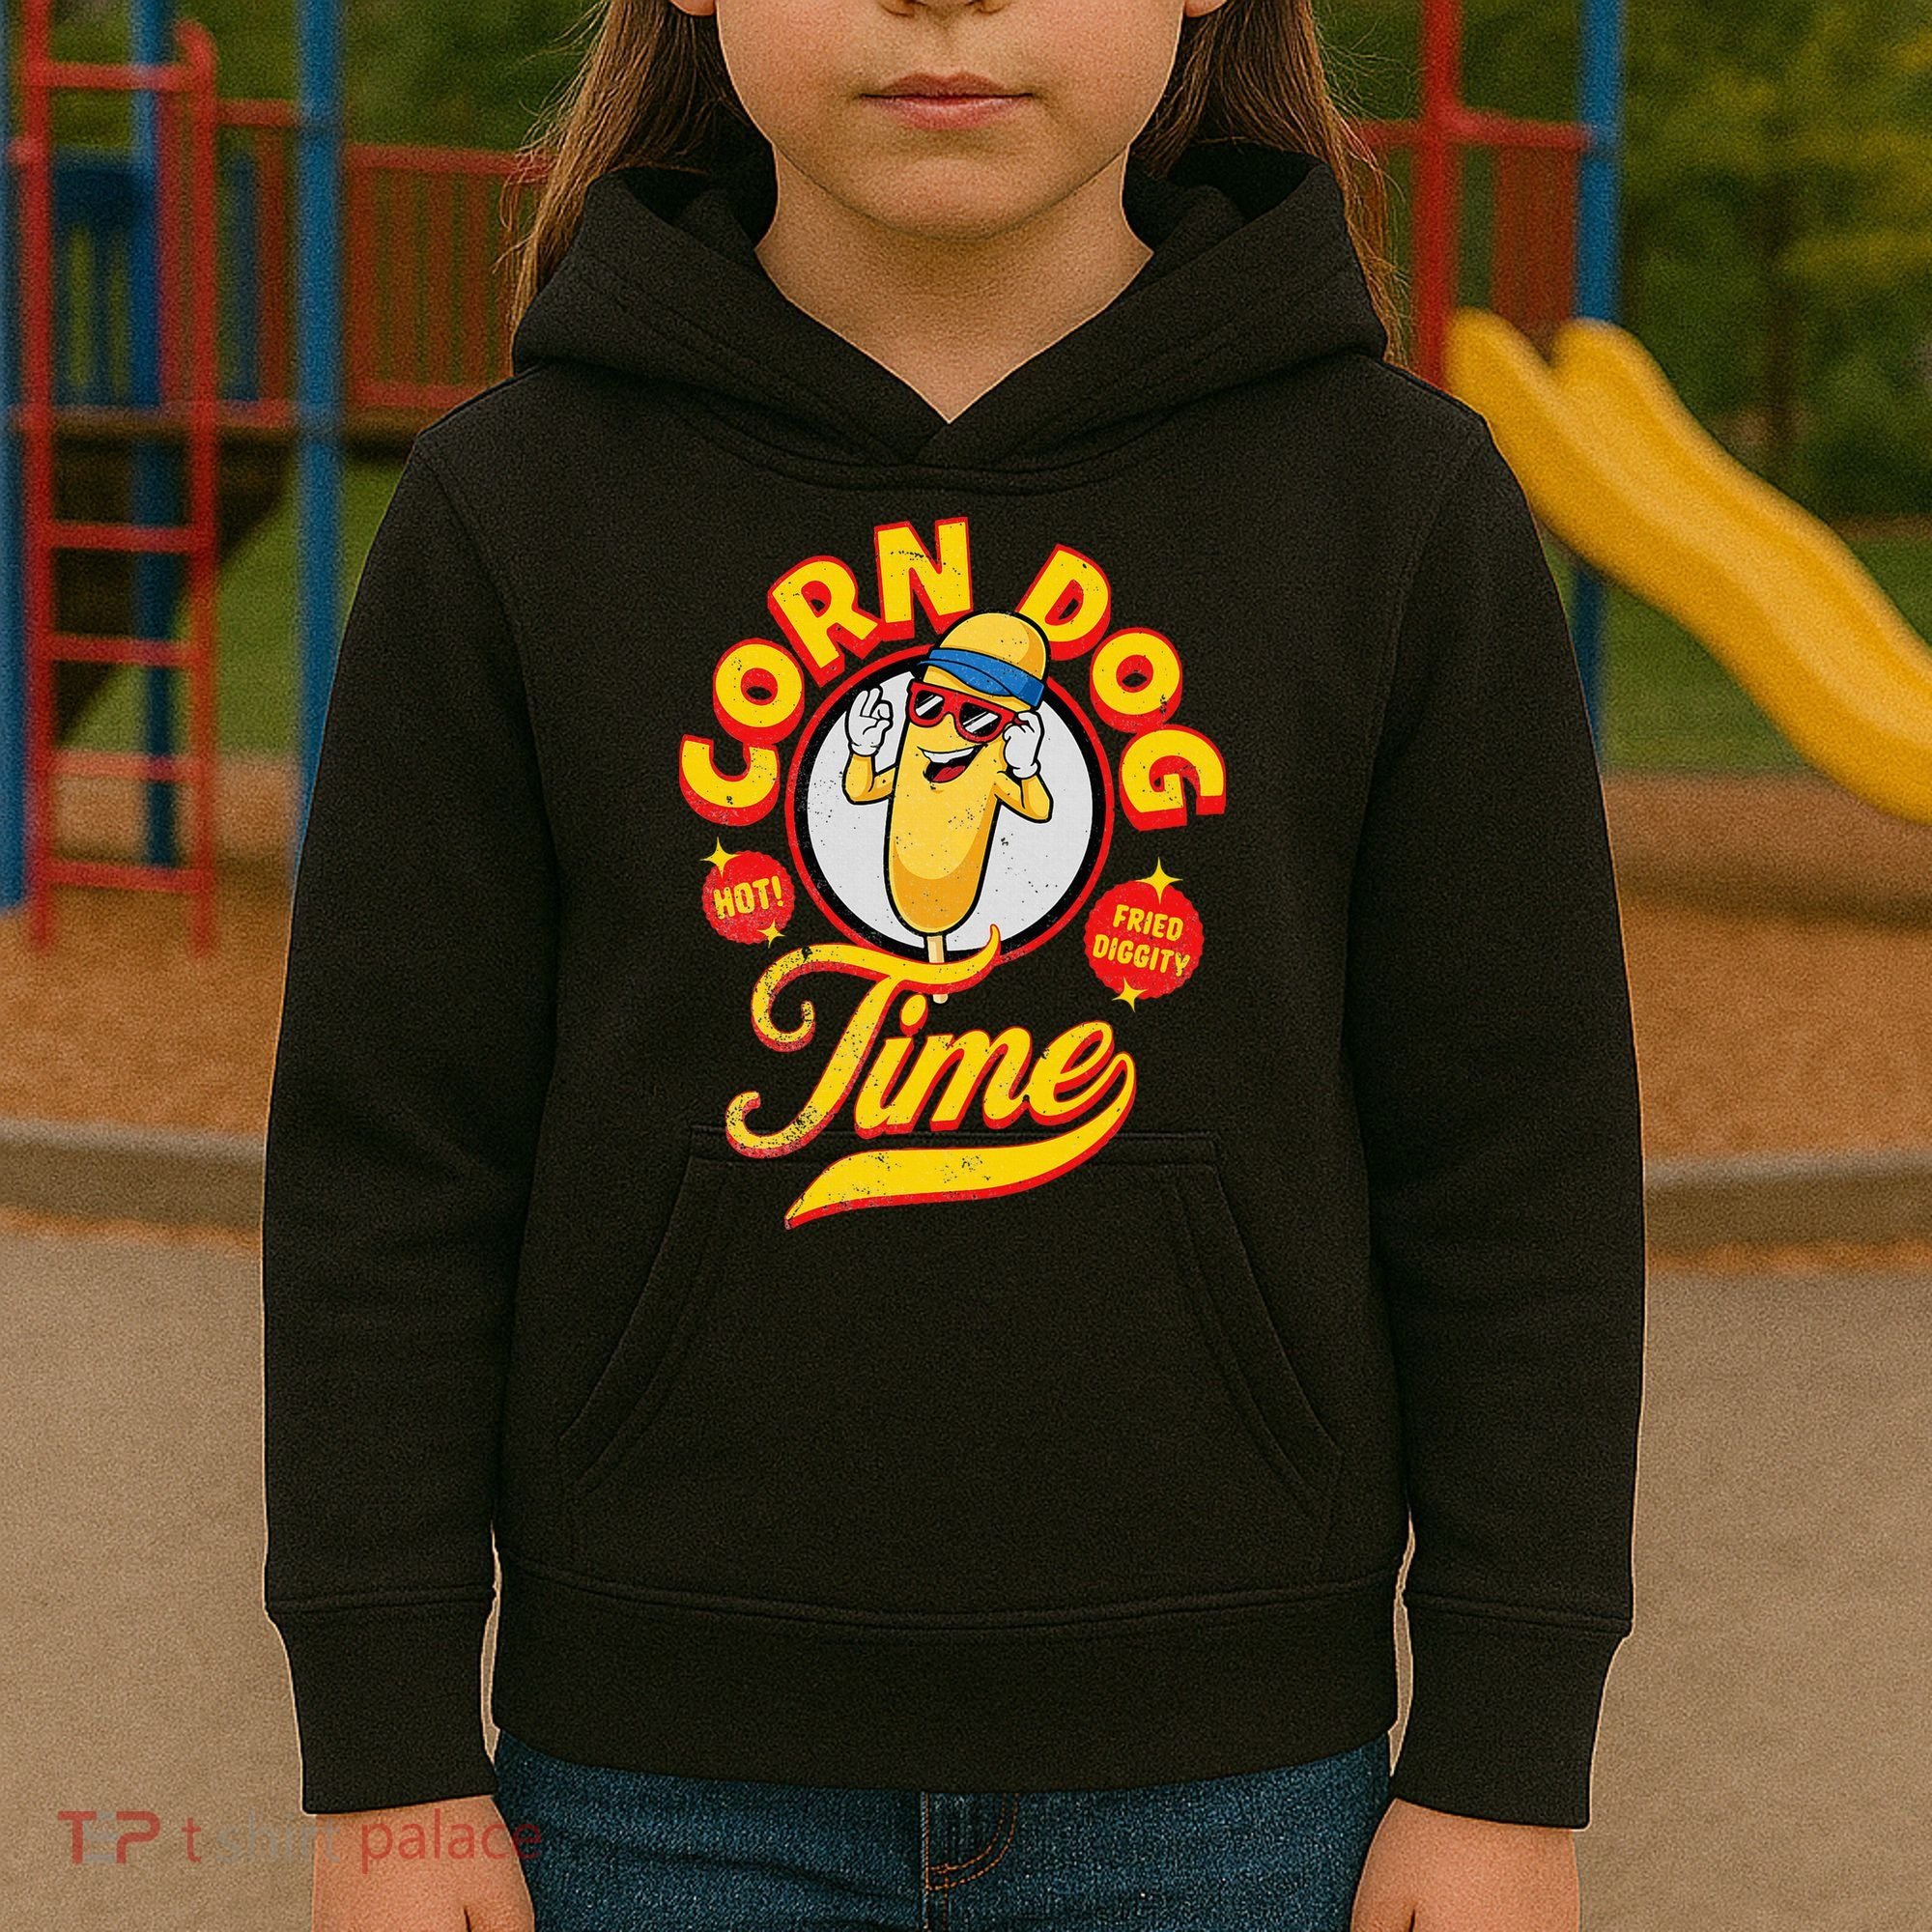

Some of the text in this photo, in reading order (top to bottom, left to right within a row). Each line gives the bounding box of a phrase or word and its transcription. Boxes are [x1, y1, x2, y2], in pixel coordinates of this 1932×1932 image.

[679, 516, 1227, 832] CORN DOG
[713, 875, 784, 920] HOT!
[1112, 903, 1184, 942] FRIED
[1092, 933, 1191, 978] DIGGITY
[725, 923, 1136, 1229] Time
